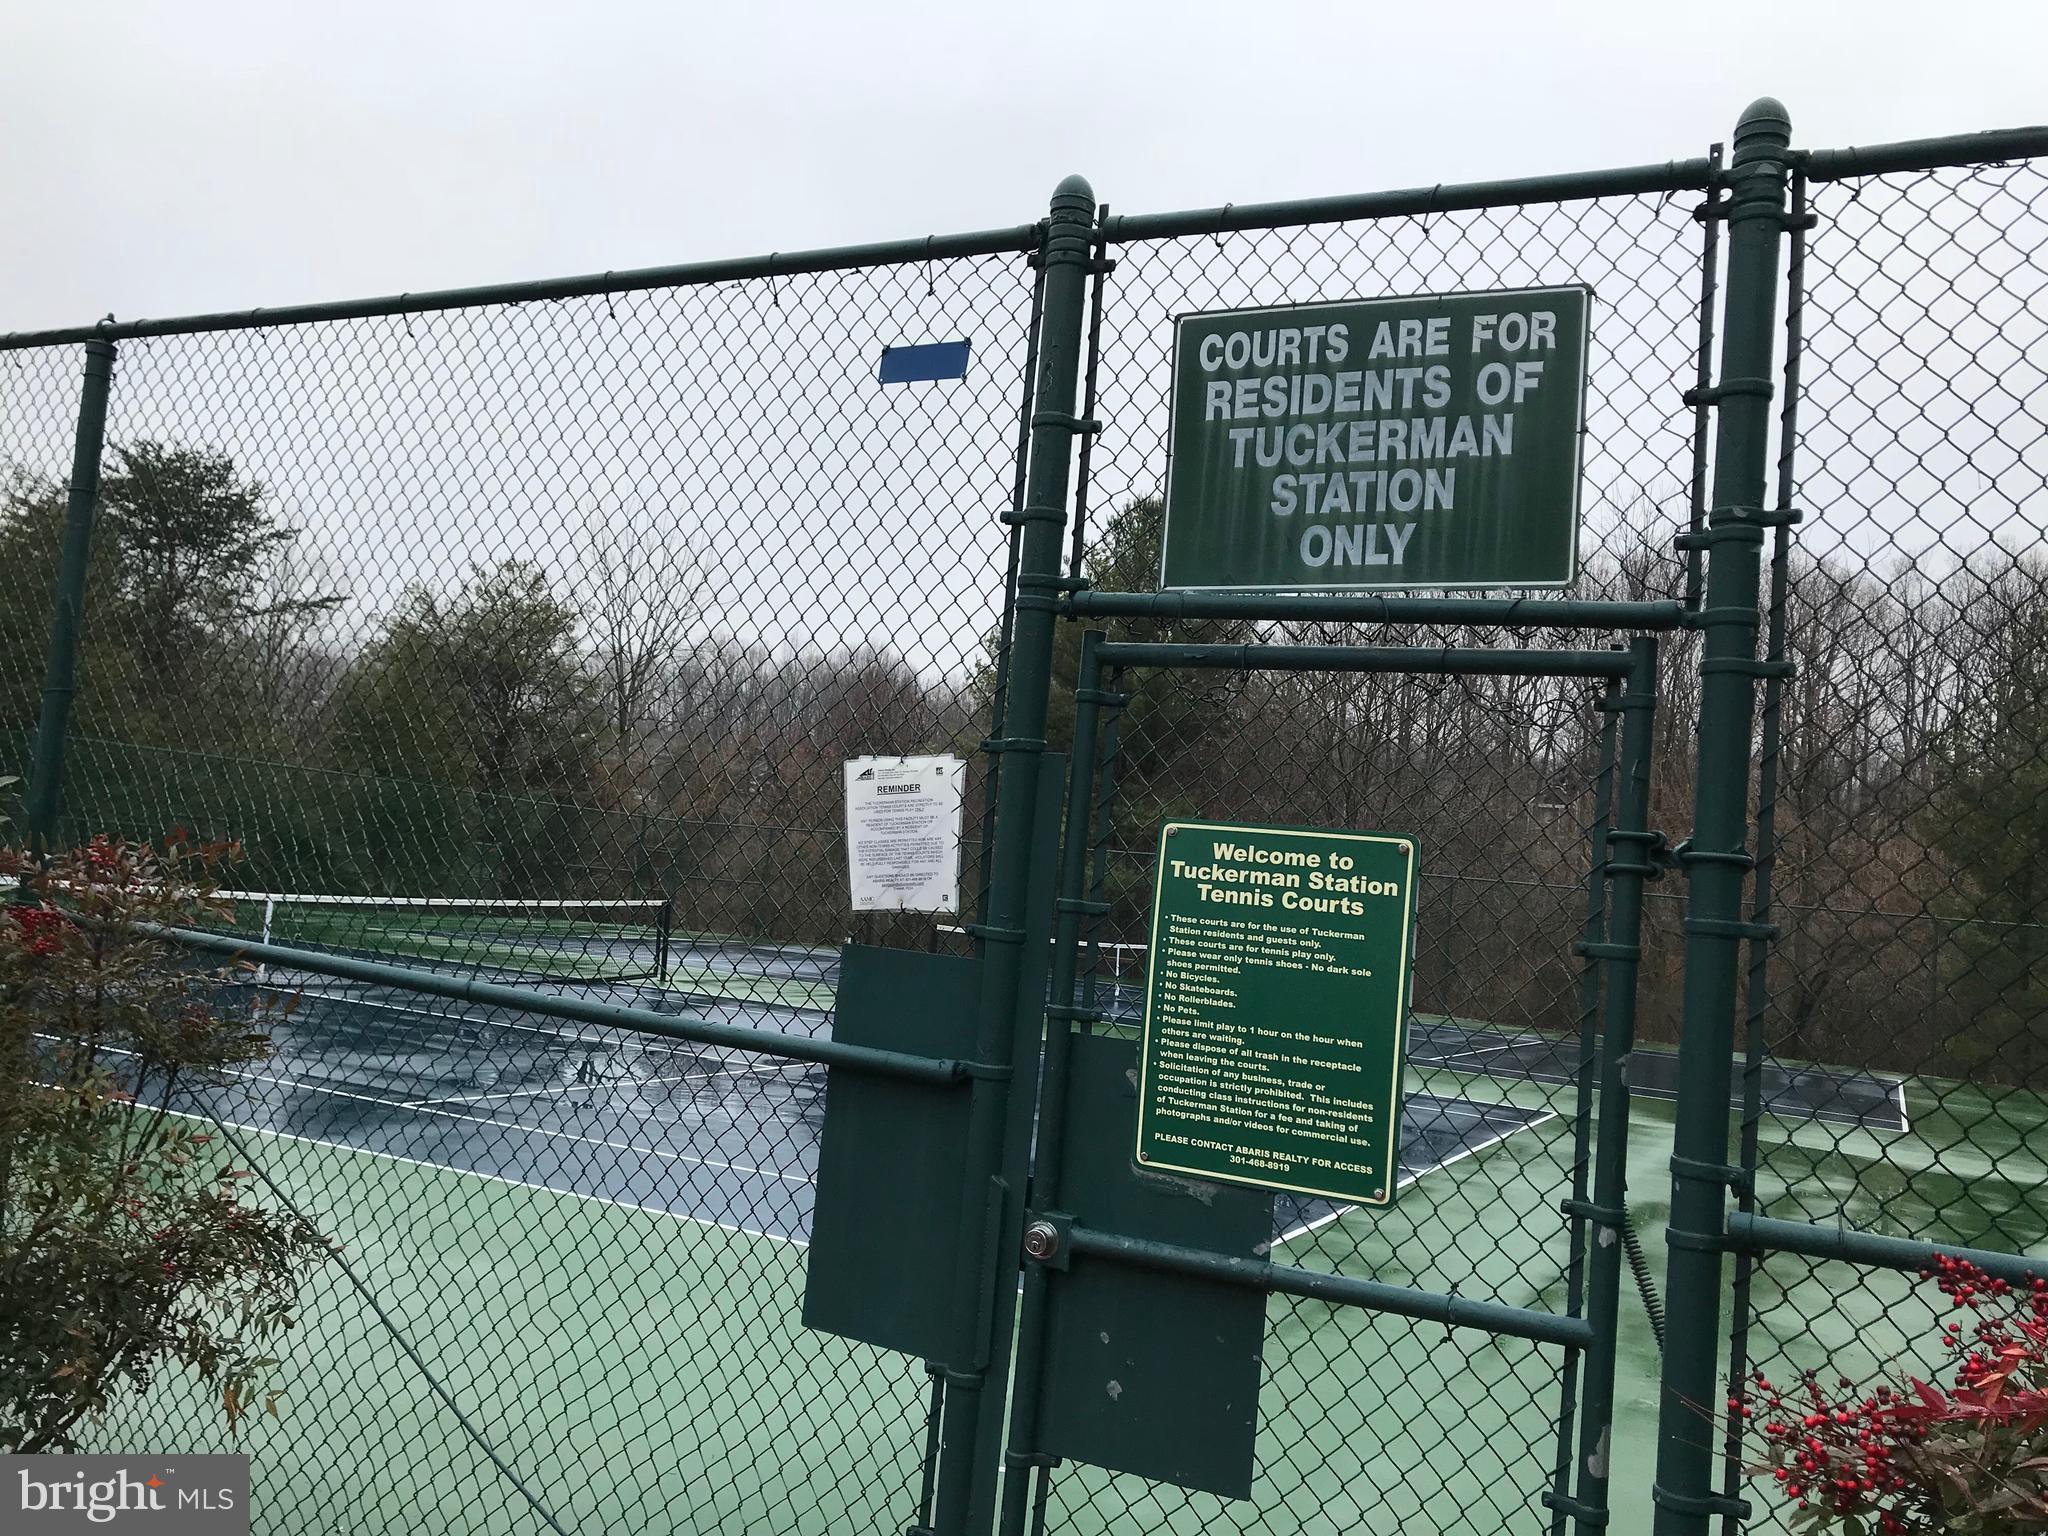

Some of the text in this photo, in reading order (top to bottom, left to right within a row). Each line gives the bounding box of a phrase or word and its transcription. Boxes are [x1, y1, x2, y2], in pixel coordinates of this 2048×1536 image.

[1199, 311, 1557, 372] COURTS ARE FOR
[1205, 361, 1545, 421] RESIDENTS OF
[1228, 413, 1514, 468] TUCKERMAN
[1271, 467, 1456, 516] STATION
[1300, 523, 1417, 567] ONLY
[877, 784, 921, 794] REMINDER
[1213, 842, 1354, 871] Welcome to
[1170, 860, 1399, 897] Tuckerman Station
[1197, 883, 1364, 916] Tennis Courts
[1169, 925, 1322, 949] Station residents and guests only.
[1170, 914, 1365, 941] These courts are for the use of Tuckerman
[1167, 947, 1198, 958] Please
[1198, 952, 1222, 961] wear
[1223, 954, 1243, 965] only
[1244, 956, 1273, 966] tennis
[1275, 959, 1303, 970] shoes
[1311, 963, 1325, 972] No
[1326, 964, 1349, 975] dark
[1351, 968, 1372, 977] sole
[1168, 936, 1336, 963] These courts are for tennis play only.
[1165, 970, 1220, 984] No Bicycles.
[1166, 959, 1241, 974] shoes permitted.
[1164, 992, 1236, 1009] No Rollerblades.
[1165, 981, 1238, 997] No Skateboards.
[1163, 1003, 1200, 1016] No Pets.
[1161, 1027, 1245, 1046] others are waiting.
[1162, 1015, 1192, 1026] Please
[1194, 1019, 1214, 1029] limit
[1216, 1022, 1236, 1033] play
[1237, 1025, 1247, 1033] to
[1249, 1026, 1255, 1034] 1
[1257, 1027, 1279, 1037] hour
[1294, 1032, 1311, 1042] the
[1312, 1034, 1335, 1045] hour
[1336, 1038, 1363, 1048] when
[1159, 1050, 1270, 1072] when leaving the courts.
[1160, 1037, 1362, 1072] Please dispose of all trash in the receptacle
[1159, 1060, 1210, 1075] Solicitation
[1211, 1068, 1221, 1077] of
[1223, 1071, 1240, 1081] any
[1241, 1072, 1285, 1087] business,
[1287, 1079, 1313, 1090] trade
[1157, 1085, 1374, 1123] conducting class instructions for non-residents
[1158, 1073, 1374, 1111] occupation is strictly prohibited. This includes
[1155, 1106, 1371, 1147] photographs and/or videos for commercial use.
[1156, 1095, 1166, 1103] of
[1167, 1096, 1218, 1111] Tuckerman
[1219, 1104, 1253, 1117] Station
[1254, 1109, 1268, 1119] for
[1278, 1113, 1294, 1123] fee
[1295, 1117, 1313, 1126] and
[1315, 1119, 1346, 1133] taking
[1348, 1124, 1359, 1133] of
[1154, 1132, 1373, 1175] PLEASE CONTACT ABARIS REALTY FOR ACCESS
[1229, 1155, 1290, 1172] 301-468-8919
